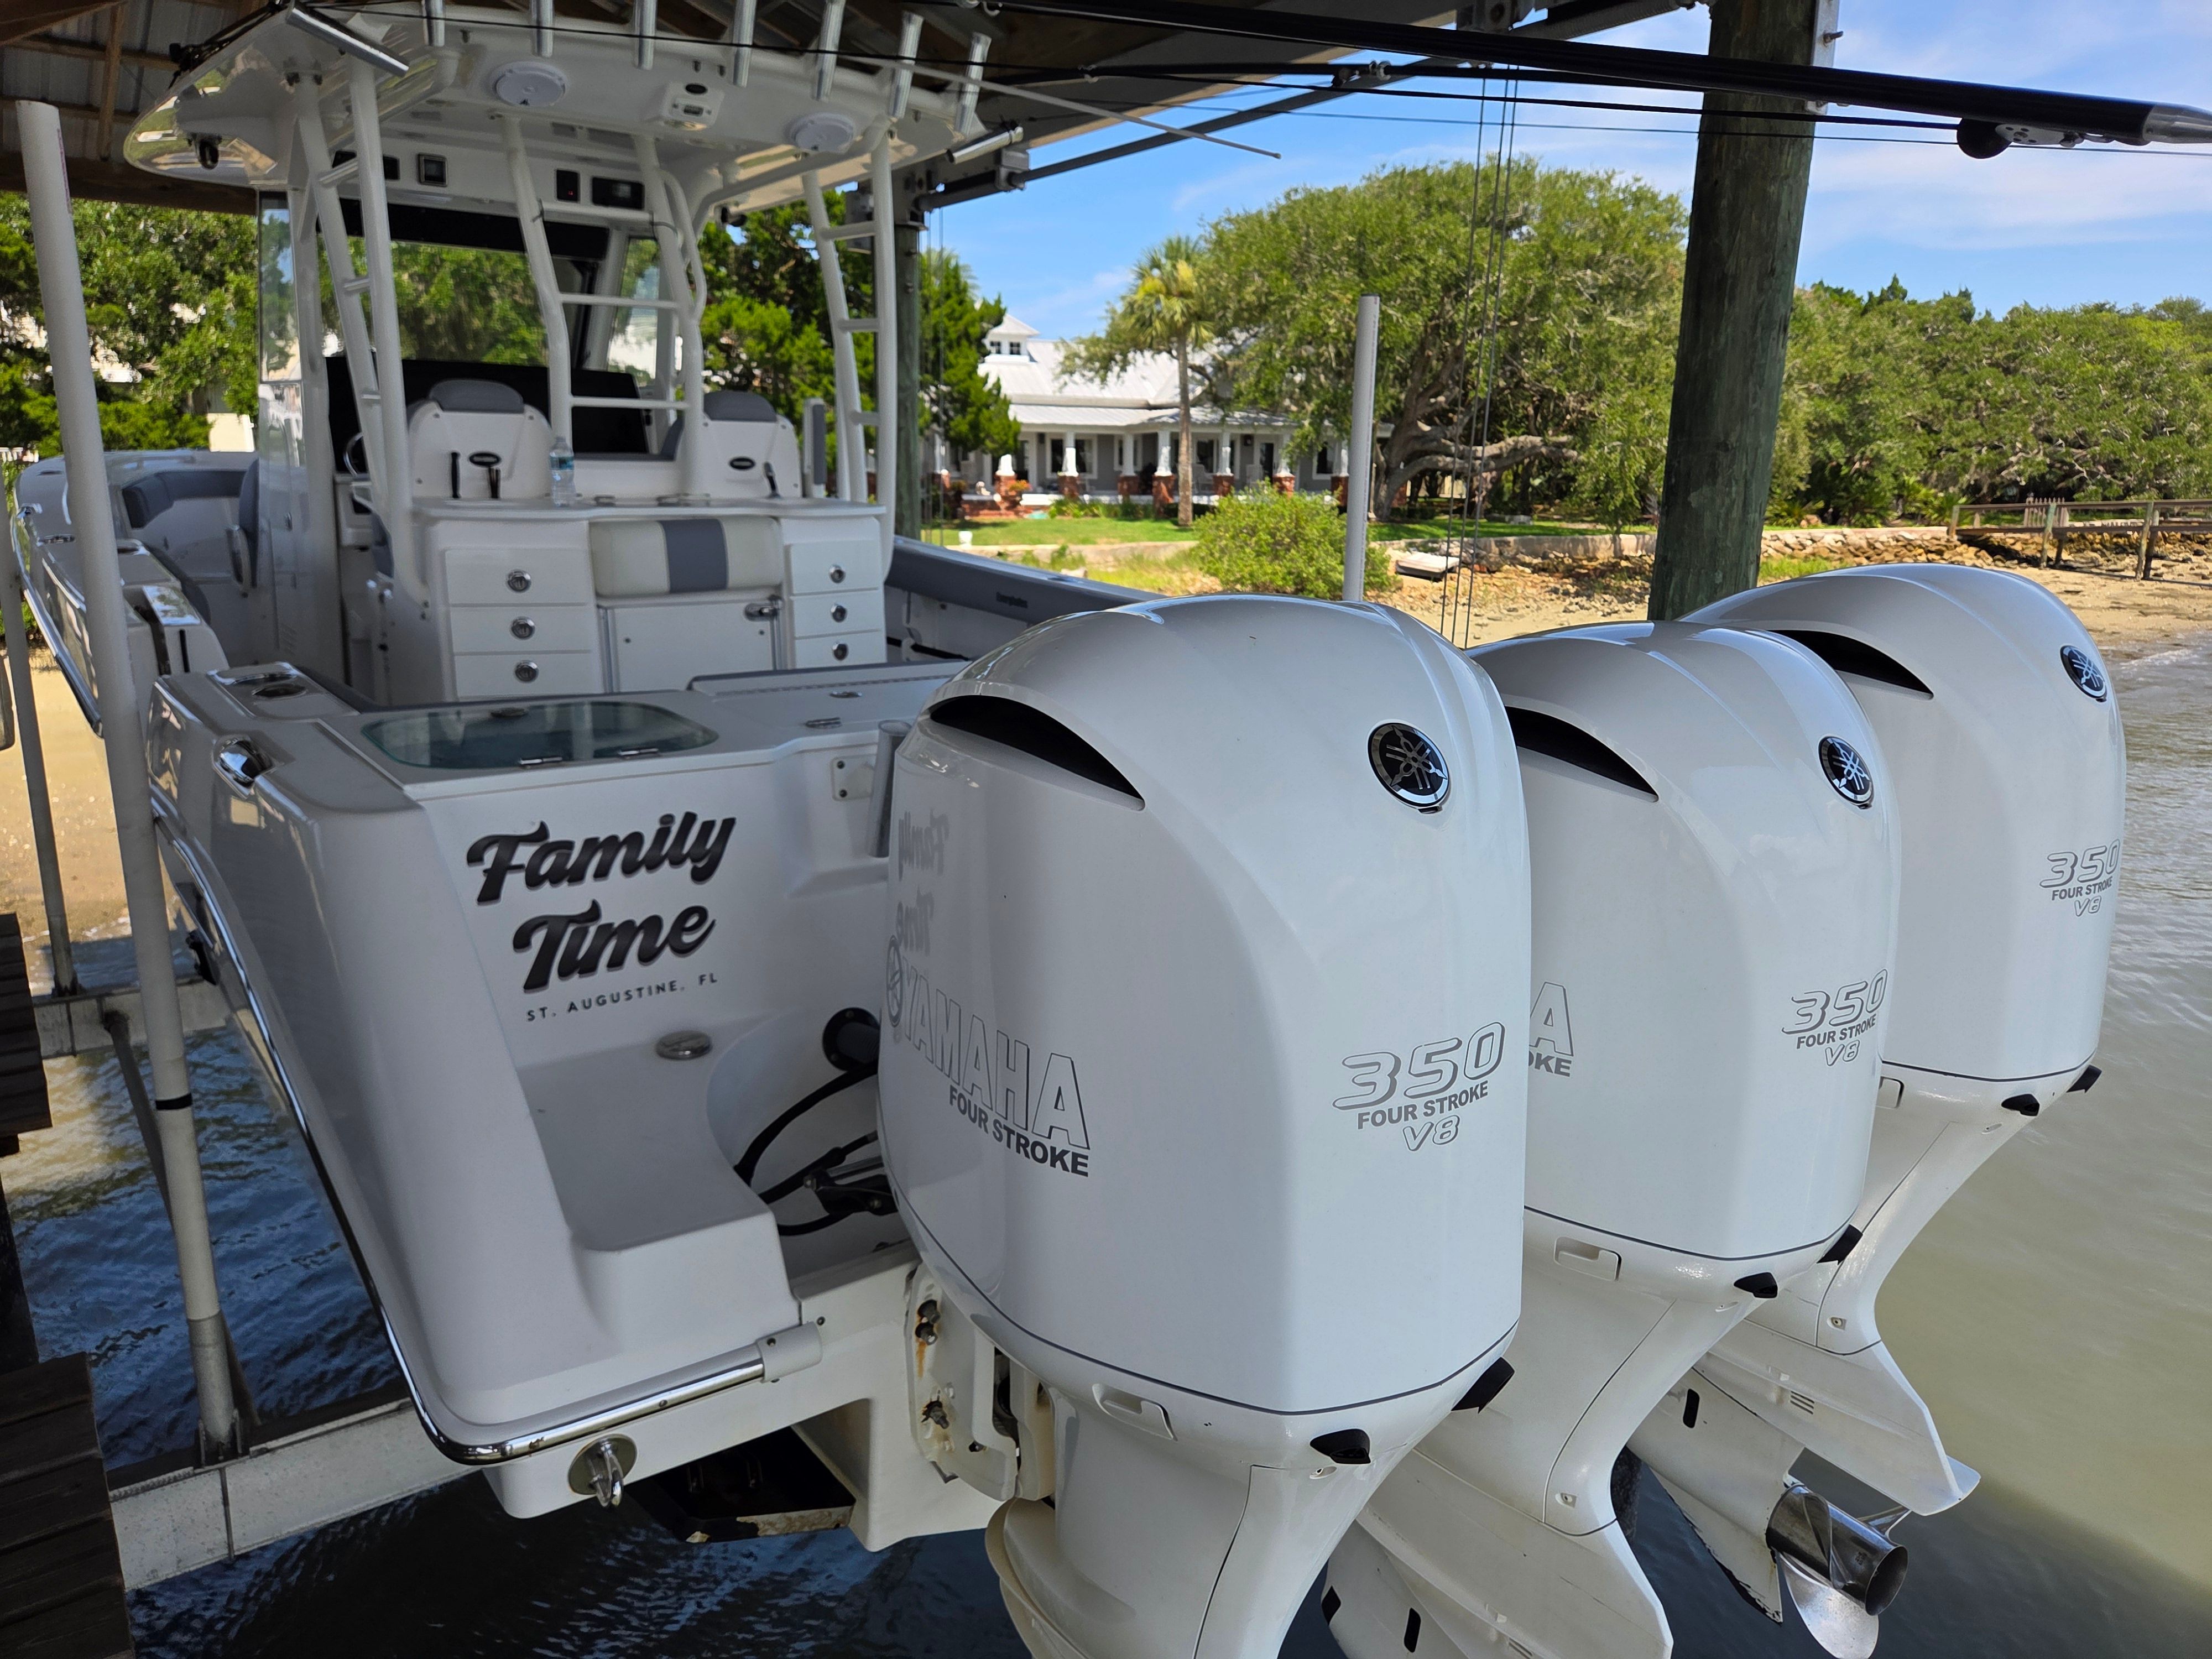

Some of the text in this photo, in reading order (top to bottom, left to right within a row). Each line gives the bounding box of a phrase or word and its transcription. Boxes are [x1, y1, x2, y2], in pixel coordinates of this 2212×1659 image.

[467, 811, 736, 906] Family
[2039, 838, 2120, 888] 350
[2051, 875, 2113, 901] FOUR STROKE
[2074, 895, 2102, 917] V8
[513, 899, 716, 993] Time
[527, 1006, 557, 1022] ST.
[699, 972, 718, 985] FL
[1781, 968, 1888, 1035] 350
[902, 954, 1091, 1150] YAMAHA
[1796, 1013, 1877, 1050] FOUR STROKE
[1825, 1039, 1860, 1066] V8
[1332, 1021, 1506, 1111] 350
[1358, 1079, 1489, 1130] FOUR STROKE
[949, 1084, 1089, 1178] FOUR STROKE
[1402, 1114, 1460, 1152] V8
